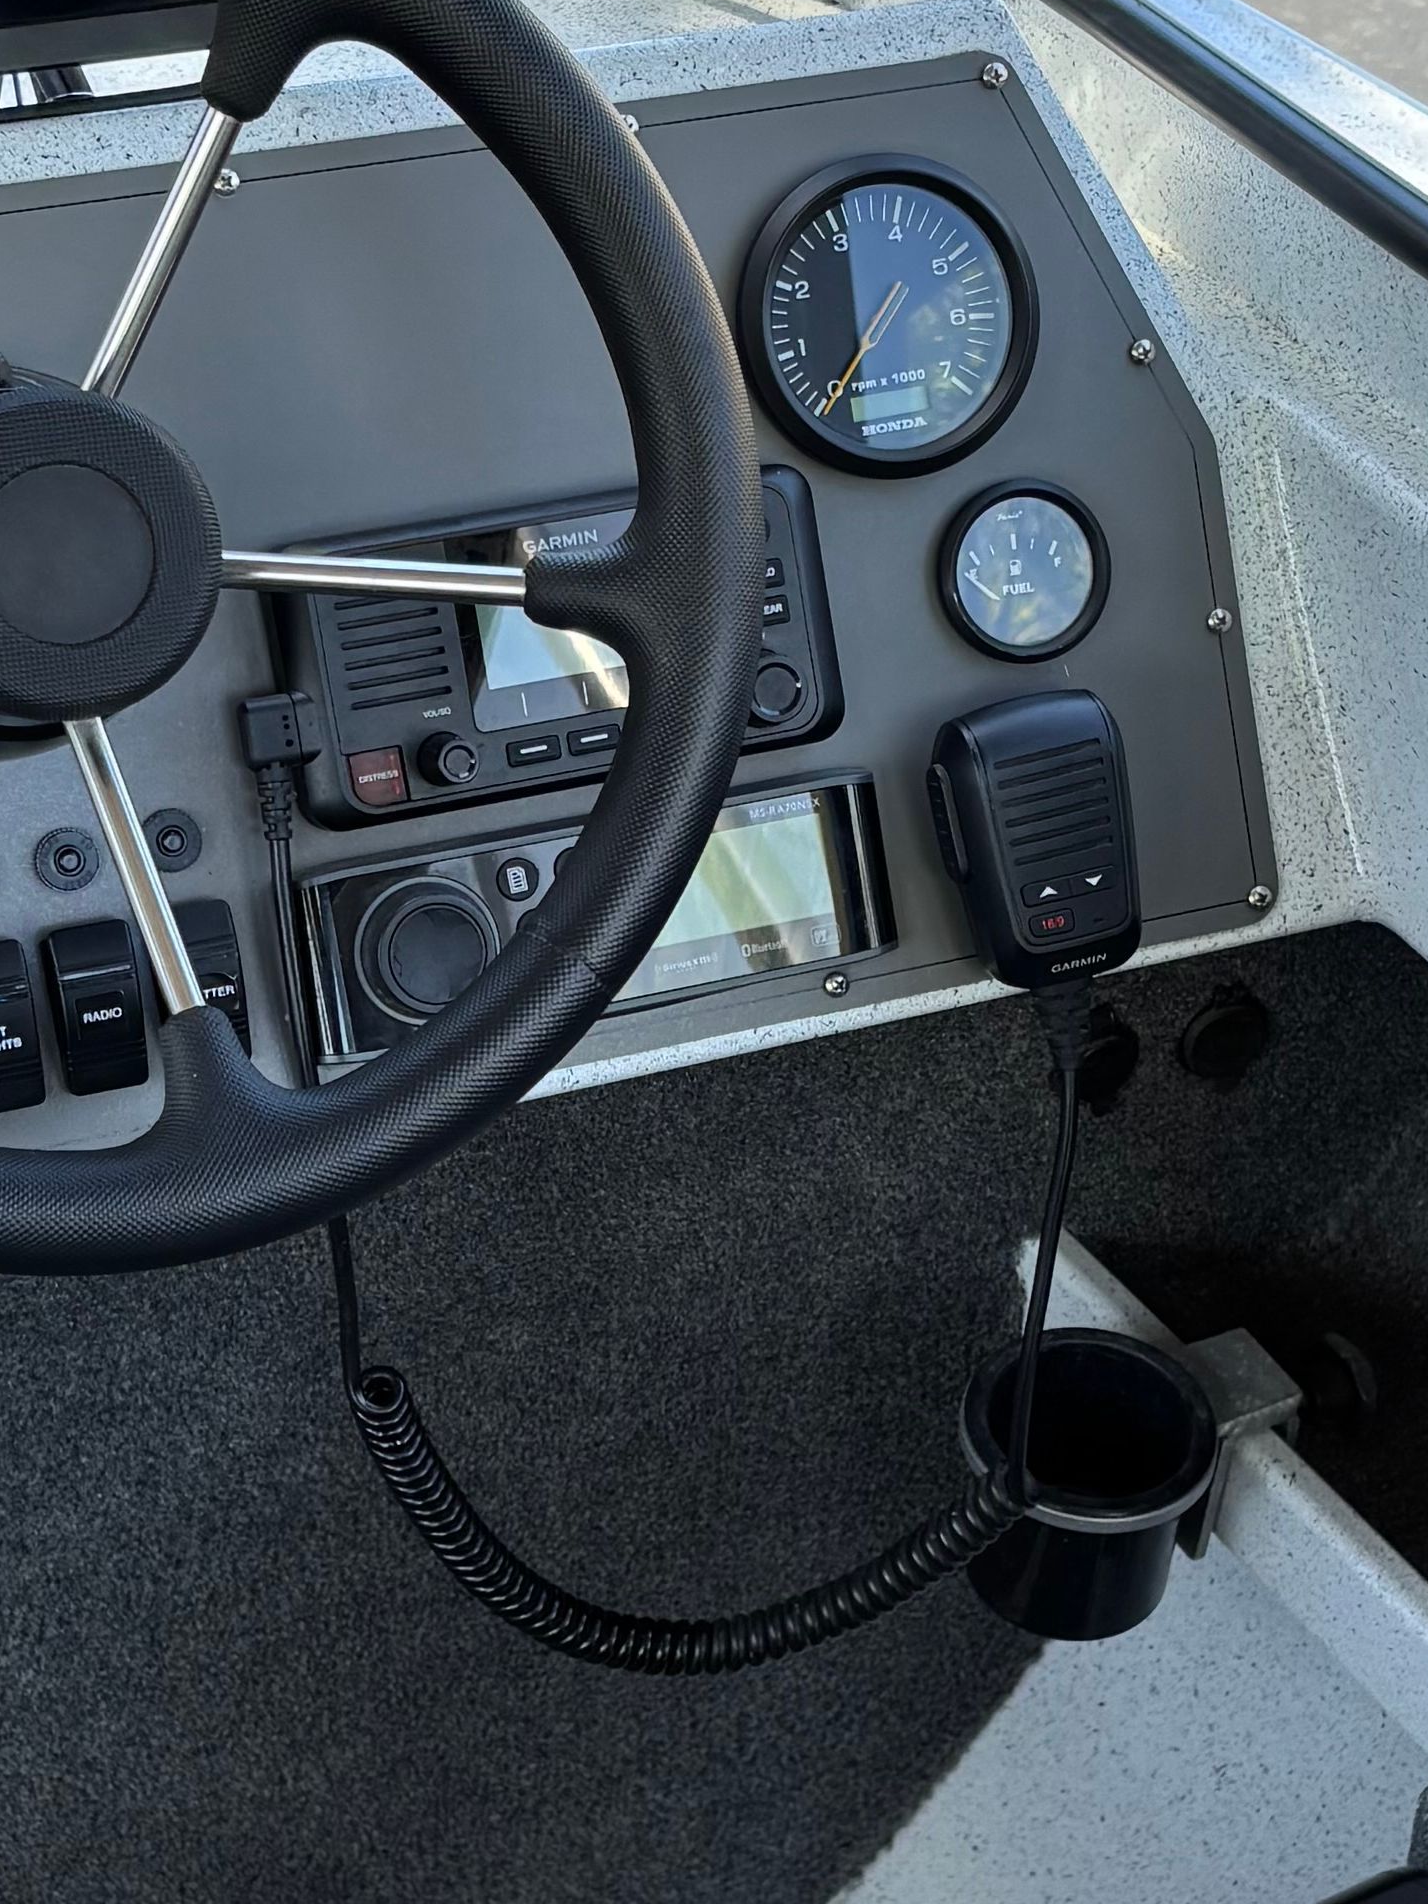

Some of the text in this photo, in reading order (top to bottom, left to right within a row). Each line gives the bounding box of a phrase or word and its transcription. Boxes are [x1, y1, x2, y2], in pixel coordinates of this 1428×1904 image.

[887, 225, 903, 242] 4
[832, 234, 849, 252] 3
[932, 258, 950, 276] 5
[794, 281, 811, 299] 2
[950, 309, 967, 326] 6
[798, 339, 807, 357] 1
[939, 361, 952, 379] 7
[851, 379, 877, 392] rpm
[891, 369, 926, 385] 1000
[862, 416, 928, 437] HONDA
[522, 528, 599, 554] GARMIN
[1002, 582, 1035, 595] FUEL
[1051, 953, 1107, 973] GARMIN
[83, 1007, 122, 1024] RADIO
